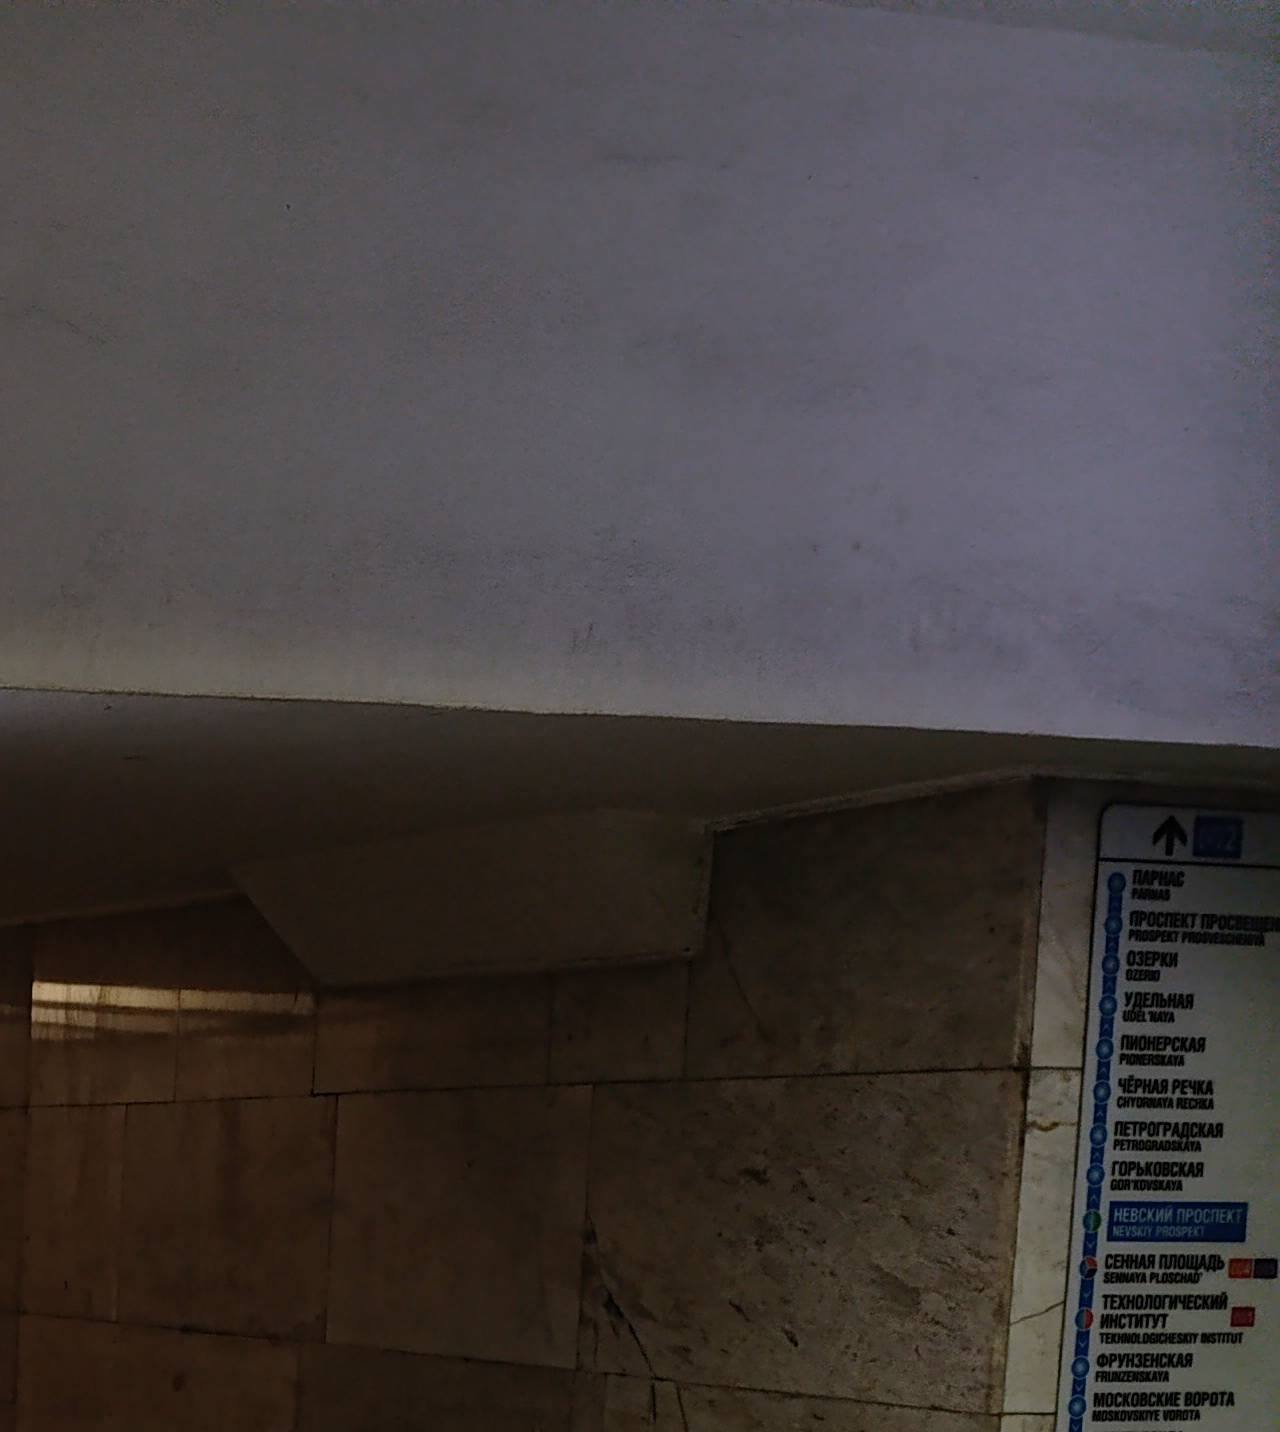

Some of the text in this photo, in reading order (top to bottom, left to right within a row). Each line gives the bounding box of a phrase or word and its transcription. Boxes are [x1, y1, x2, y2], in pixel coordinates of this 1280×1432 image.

[1132, 869, 1185, 888] ПАРНАС
[1130, 912, 1198, 930] ПРОСПЕКТ
[1129, 931, 1180, 944] PROSPEKT
[1127, 951, 1178, 968] ОЗЕРКИ
[1124, 992, 1194, 1010] УДЕЛЬНАЯ
[1121, 1035, 1206, 1054] ПИОНЕРСКАЯ
[1119, 1054, 1185, 1067] PIONERSKAYA
[1172, 1079, 1214, 1096] РЕЧКА
[1114, 1120, 1224, 1140] ПЕТРОГРАДСКАЯ
[1113, 1140, 1202, 1152] PETROGRADSKAYA
[1111, 1161, 1204, 1178] ГОРЬКОВСКАЯ
[1114, 1205, 1244, 1226] НЕВСКИЙ ПРОСПЕКТ
[1155, 1226, 1206, 1238] PROSPEKT
[1104, 1254, 1155, 1271] СЕННАЯ
[1158, 1255, 1225, 1273] ПЛОЩАДЬ
[1102, 1292, 1229, 1310] ТЕХНОЛОГИЧЕСКИЙ
[1100, 1313, 1169, 1330] ИНСТИТУТ
[1096, 1353, 1193, 1369] ФРУНЗЕНСКАЯ
[1095, 1370, 1170, 1383] FRUNZENSKAYA
[1093, 1391, 1235, 1407] МОСКОВСКИЕ ВОРОТА
